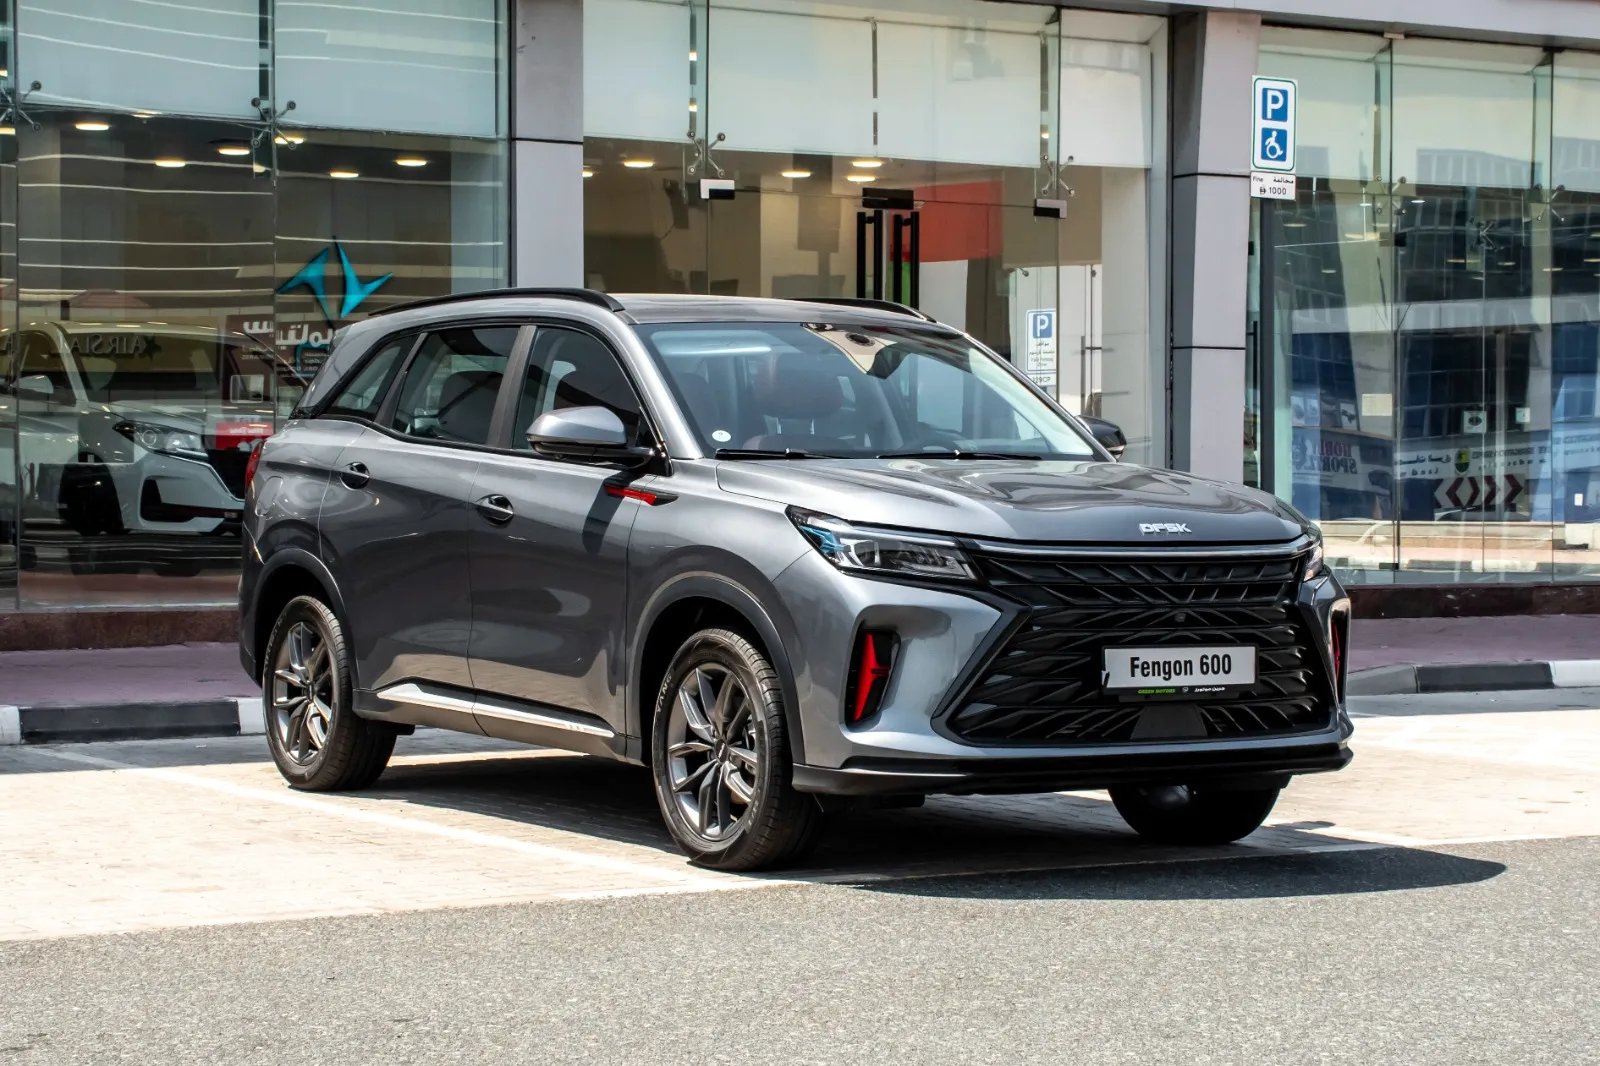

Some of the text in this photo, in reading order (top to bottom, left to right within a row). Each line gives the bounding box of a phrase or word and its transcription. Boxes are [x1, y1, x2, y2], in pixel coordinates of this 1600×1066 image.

[1266, 89, 1284, 119] P
[1269, 187, 1287, 195] 1000
[1037, 315, 1049, 337] P
[1139, 523, 1192, 534] DFSK
[1129, 654, 1232, 681] Fengon 600
